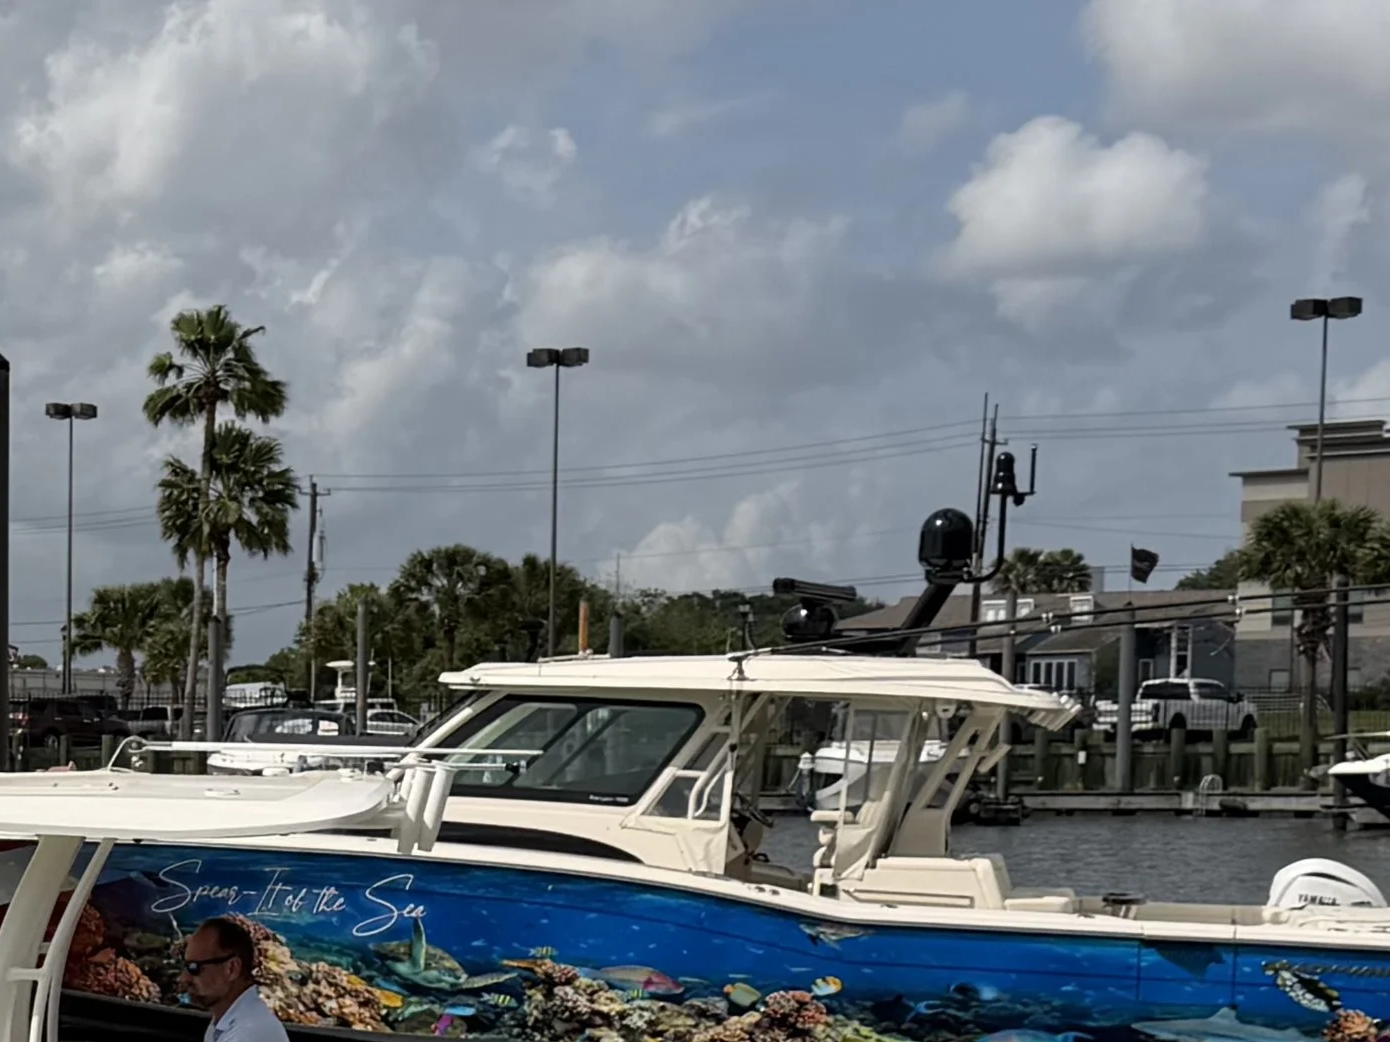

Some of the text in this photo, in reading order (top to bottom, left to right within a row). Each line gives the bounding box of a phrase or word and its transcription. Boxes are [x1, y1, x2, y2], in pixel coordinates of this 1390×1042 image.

[284, 885, 305, 914] of
[311, 884, 347, 914] the
[352, 873, 428, 937] Sea
